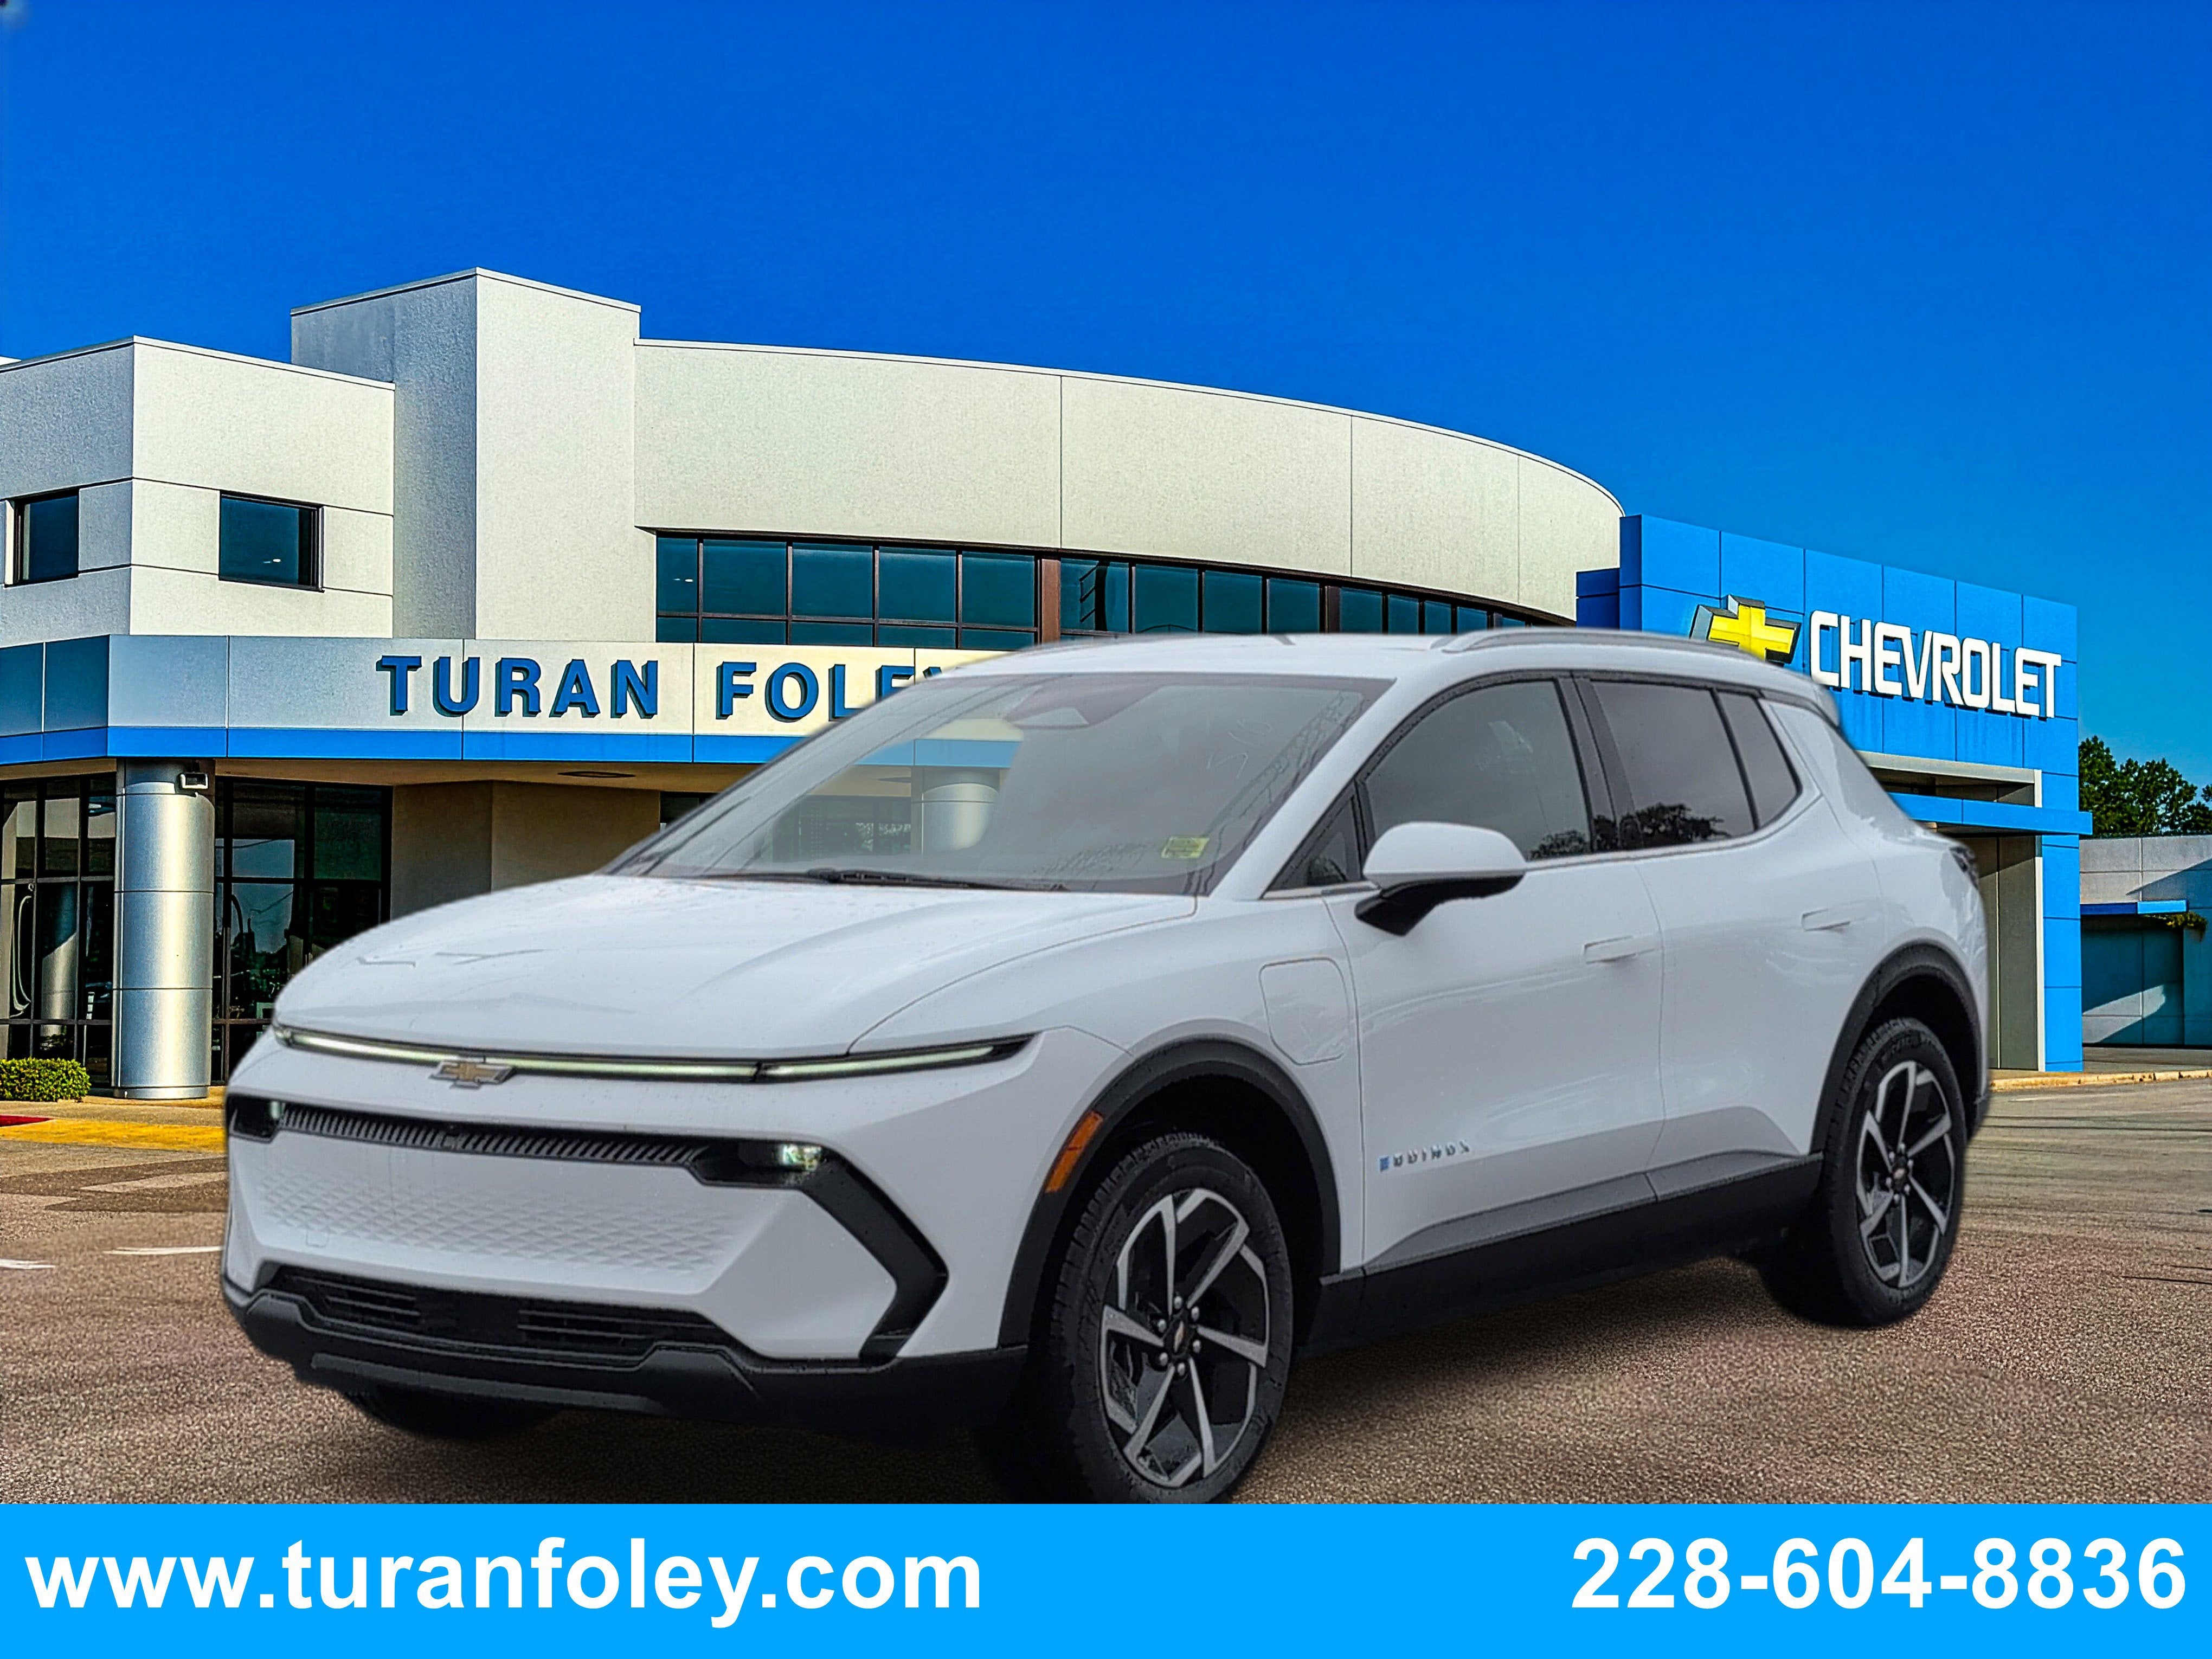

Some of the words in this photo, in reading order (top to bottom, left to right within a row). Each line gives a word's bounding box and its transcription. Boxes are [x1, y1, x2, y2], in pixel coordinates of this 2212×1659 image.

[376, 655, 659, 719] TURAN
[716, 661, 943, 722] FOLE
[1810, 609, 2062, 719] CHEVROLET
